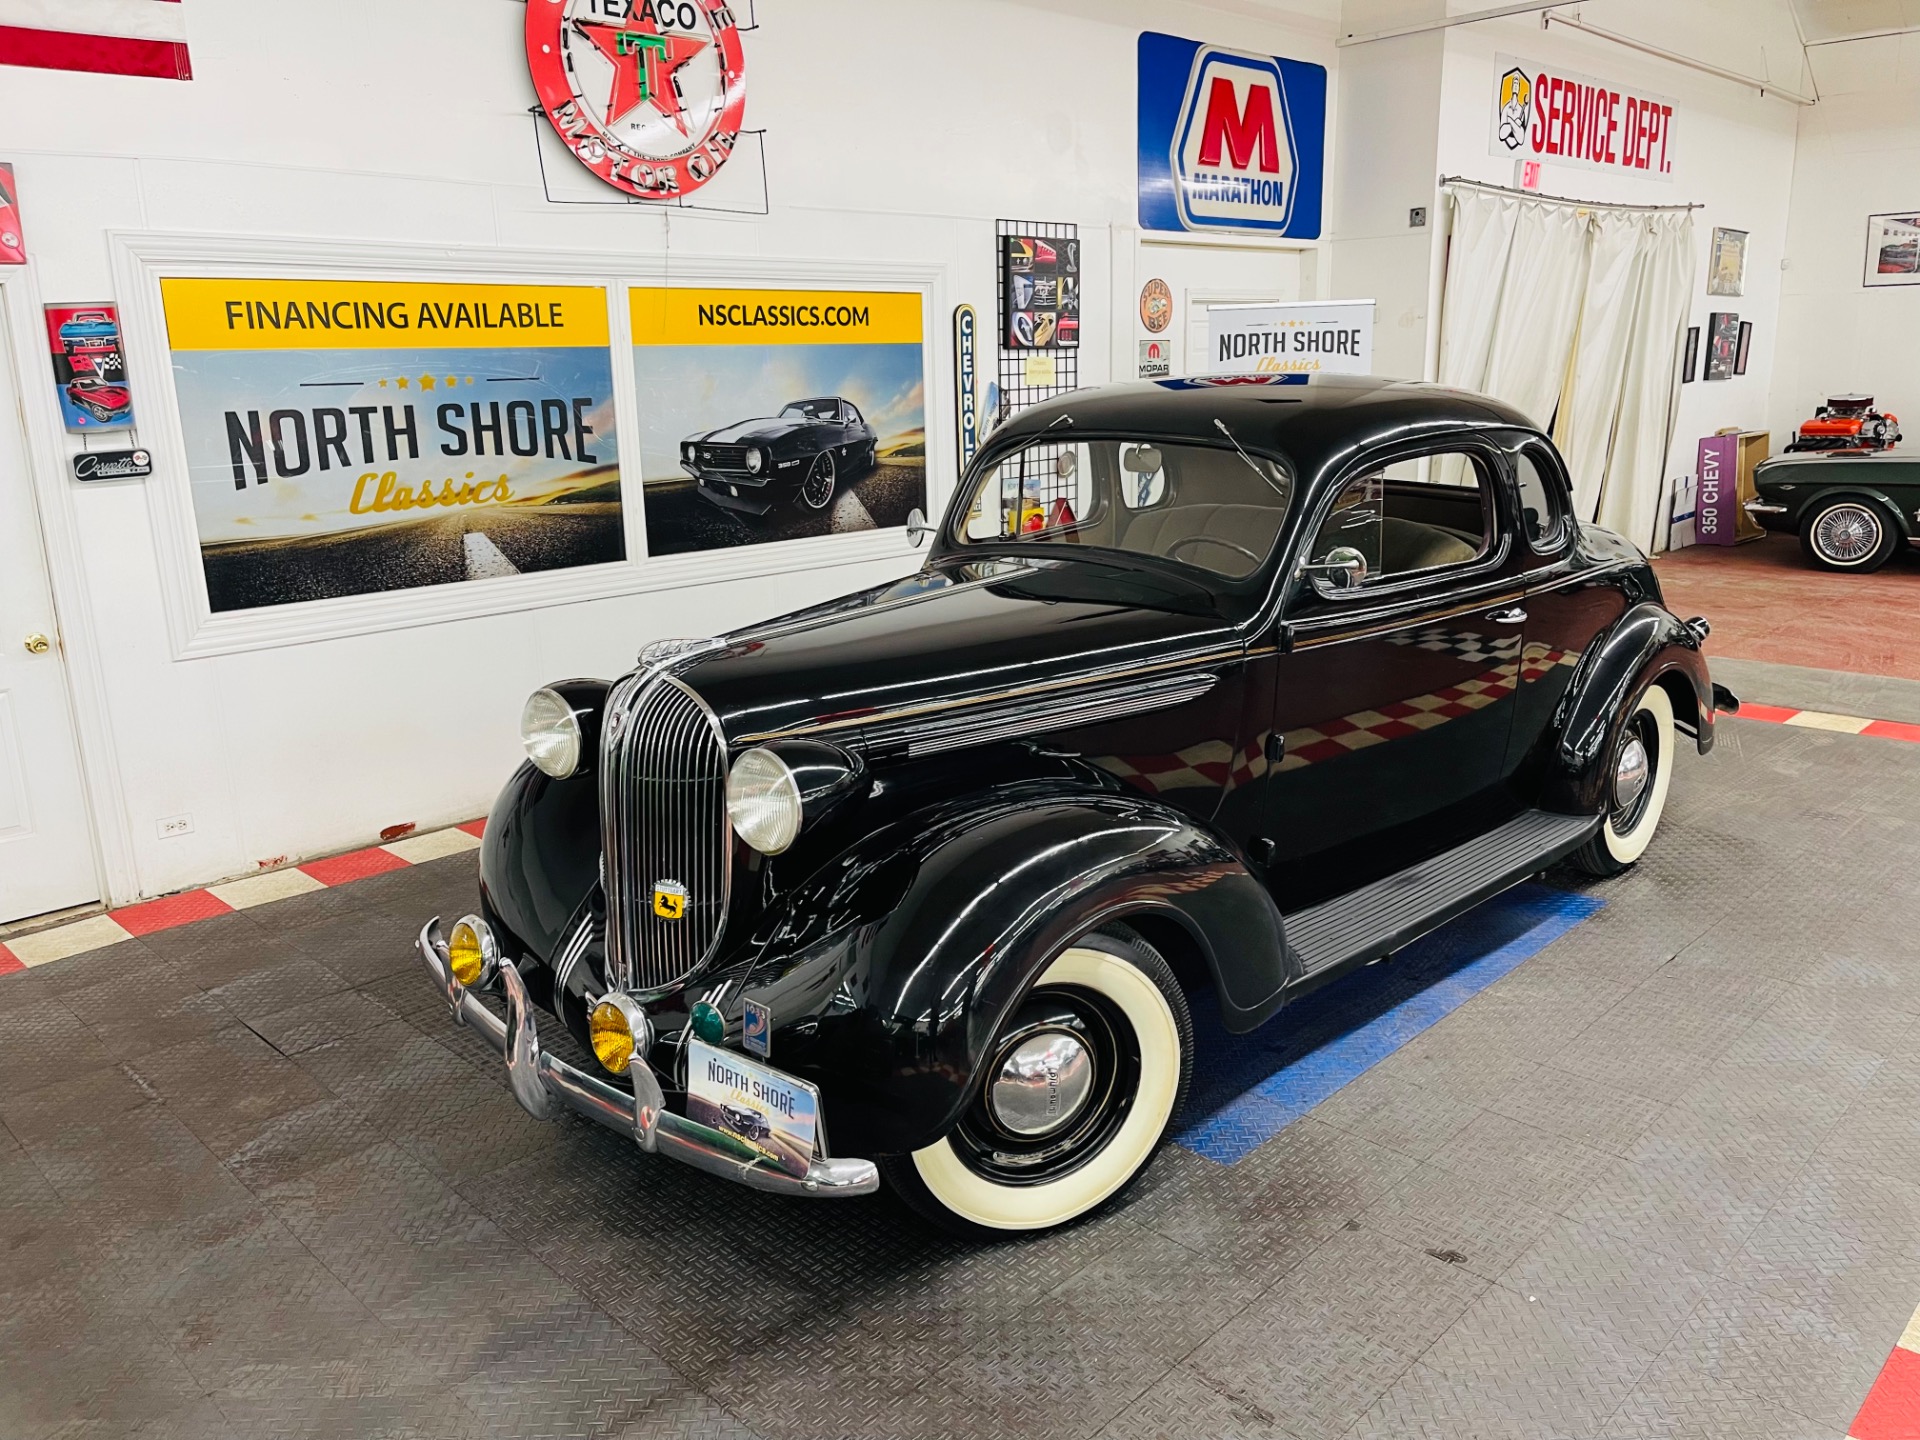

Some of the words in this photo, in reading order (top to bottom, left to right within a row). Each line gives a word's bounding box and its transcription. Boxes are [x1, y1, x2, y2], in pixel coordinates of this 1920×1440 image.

[1197, 76, 1279, 173] M
[1531, 73, 1620, 164] SERVICE
[1622, 96, 1672, 174] DEPT.
[552, 99, 680, 195] MOTOR
[1192, 172, 1283, 207] MARATHON
[225, 301, 409, 330] FINANCING
[416, 303, 564, 329] AVAILABLE
[698, 304, 870, 326] NSCLASSICS.COM
[1147, 310, 1168, 330] BEE
[1219, 333, 1286, 362] NORTH
[1293, 329, 1361, 357] SHORE
[1139, 364, 1169, 373] MOPAR
[1256, 356, 1321, 372] Classics
[961, 315, 975, 467] CHEVROLE
[224, 404, 420, 491] NORTH
[436, 397, 598, 465] SHORE
[76, 456, 135, 477] Corvette
[1702, 448, 1720, 504] CHEVY
[349, 471, 515, 515] Classics
[1701, 507, 1718, 534] 350
[708, 1060, 748, 1092] NORTH
[753, 1080, 795, 1120] SHORE
